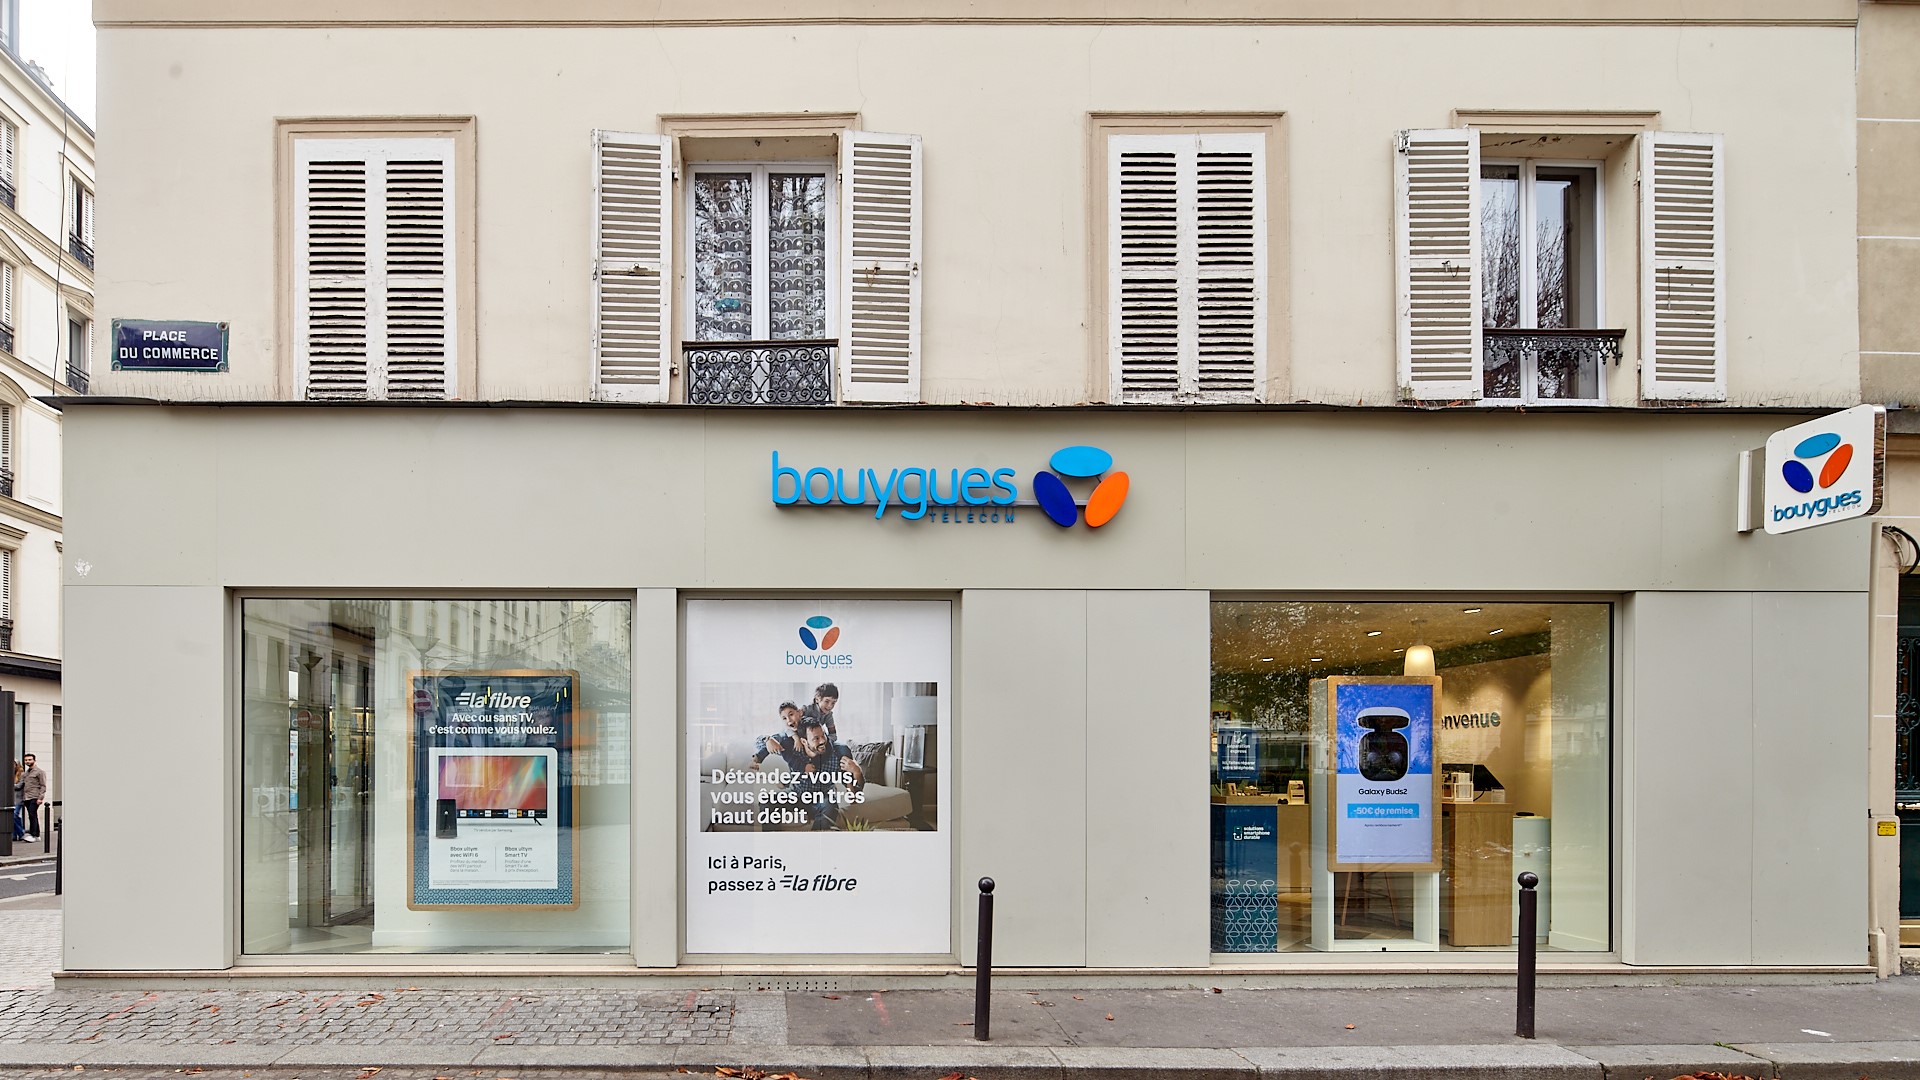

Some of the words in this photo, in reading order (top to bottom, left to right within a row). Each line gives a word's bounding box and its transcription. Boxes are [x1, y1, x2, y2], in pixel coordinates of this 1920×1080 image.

[143, 330, 187, 342] PLACE
[120, 347, 138, 359] DU
[143, 347, 219, 360] COMMERCE
[772, 450, 1018, 521] bouygues
[1773, 489, 1862, 522] bouygues
[1828, 503, 1862, 514] TELECOM
[929, 512, 1015, 524] TELECOM
[786, 650, 853, 669] bouygues
[470, 694, 484, 708] la
[488, 693, 532, 708] fibre
[452, 713, 478, 722] Avec
[519, 713, 534, 724] TV,
[1441, 712, 1501, 730] nvenue
[429, 725, 454, 734] c'est
[521, 725, 558, 734] voulez.
[711, 768, 858, 786] Détendez-vous,
[710, 791, 754, 804] vous
[758, 788, 798, 804] êtes
[801, 791, 824, 804] en
[827, 788, 865, 804] très
[711, 808, 754, 824] haut
[757, 808, 808, 824] débit
[1374, 806, 1385, 814] de
[1386, 806, 1414, 814] remise
[708, 856, 726, 869] Ici
[730, 856, 739, 869] à
[744, 856, 786, 872] Paris,
[708, 880, 764, 895] passez
[767, 878, 776, 891] à
[792, 875, 809, 891] la
[812, 874, 857, 891] fibre
